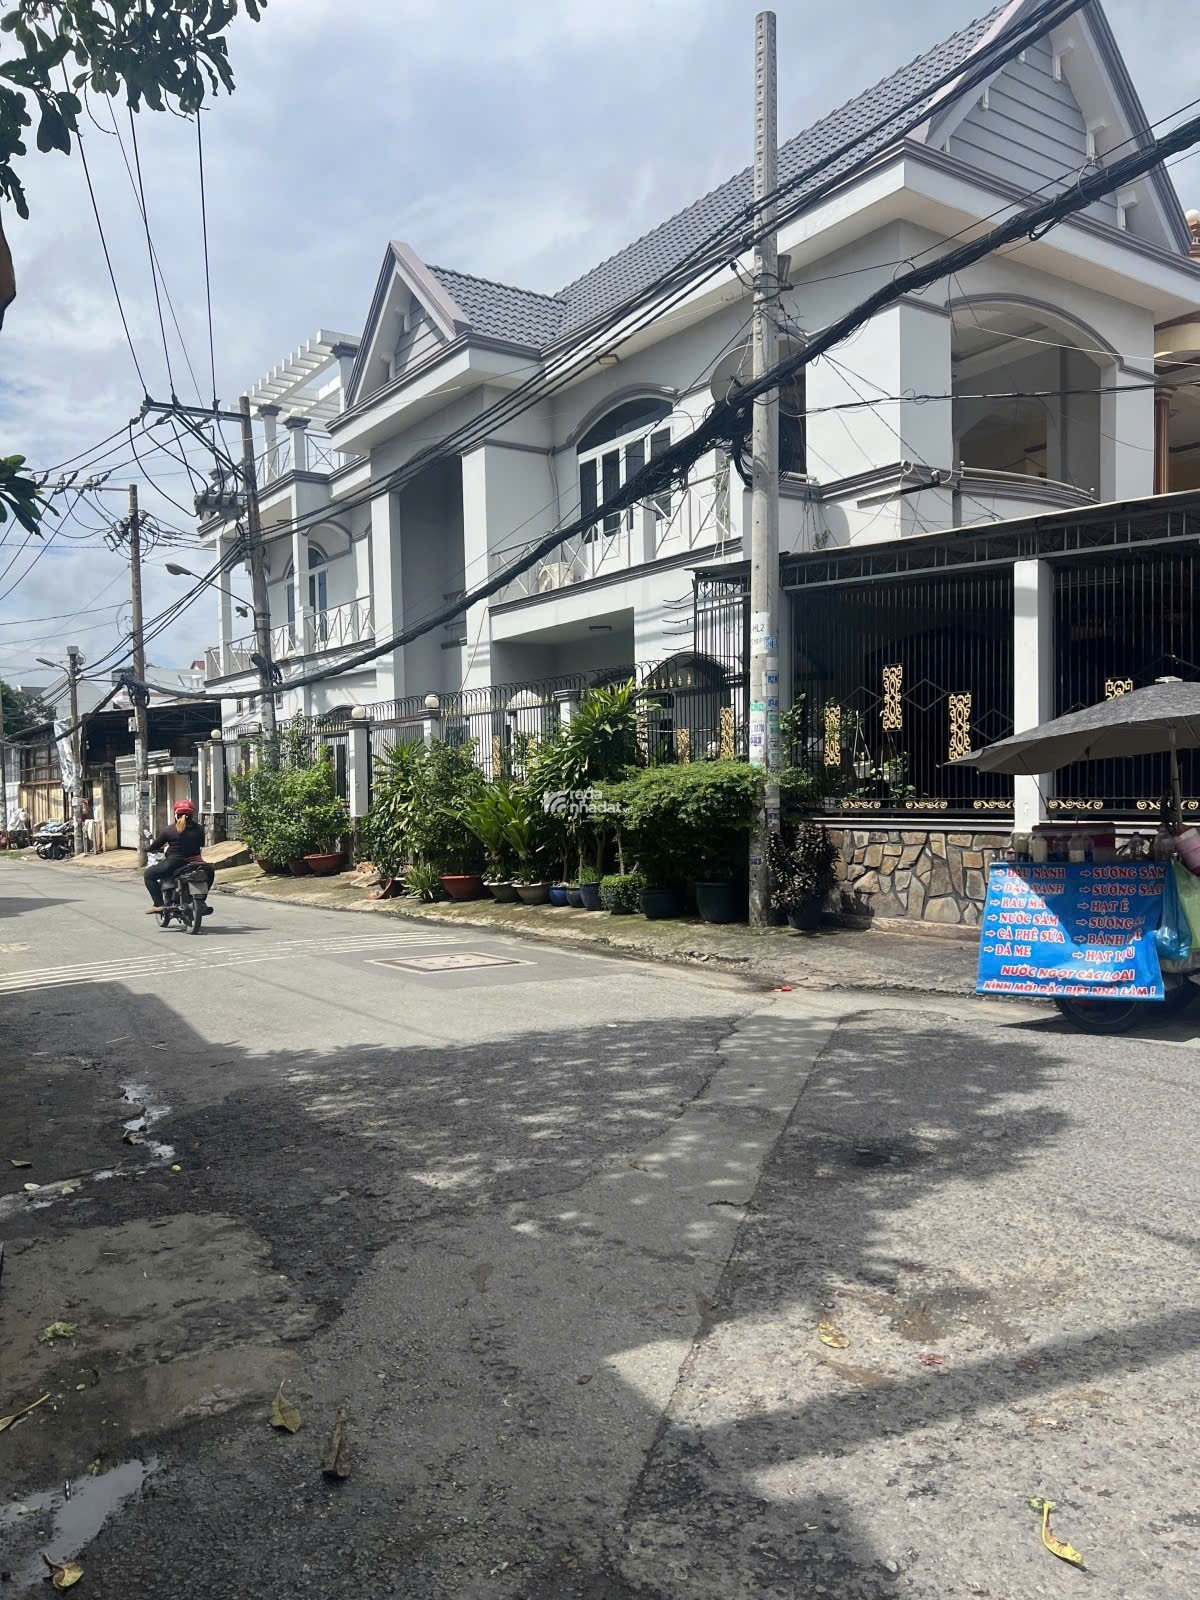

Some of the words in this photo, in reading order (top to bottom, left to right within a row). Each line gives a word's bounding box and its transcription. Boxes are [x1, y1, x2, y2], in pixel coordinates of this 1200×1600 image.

[1031, 883, 1064, 894] XANH
[1001, 897, 1026, 909] RAU
[1033, 912, 1059, 926] SÂM
[1015, 927, 1038, 941] PHÊ
[1087, 931, 1124, 946] BÁNH
[995, 942, 1012, 956] ĐÁ
[1014, 945, 1031, 957] ME
[1085, 950, 1113, 965] HẠT
[1001, 964, 1036, 977] NƯỚC
[1037, 967, 1075, 981] NGỌT
